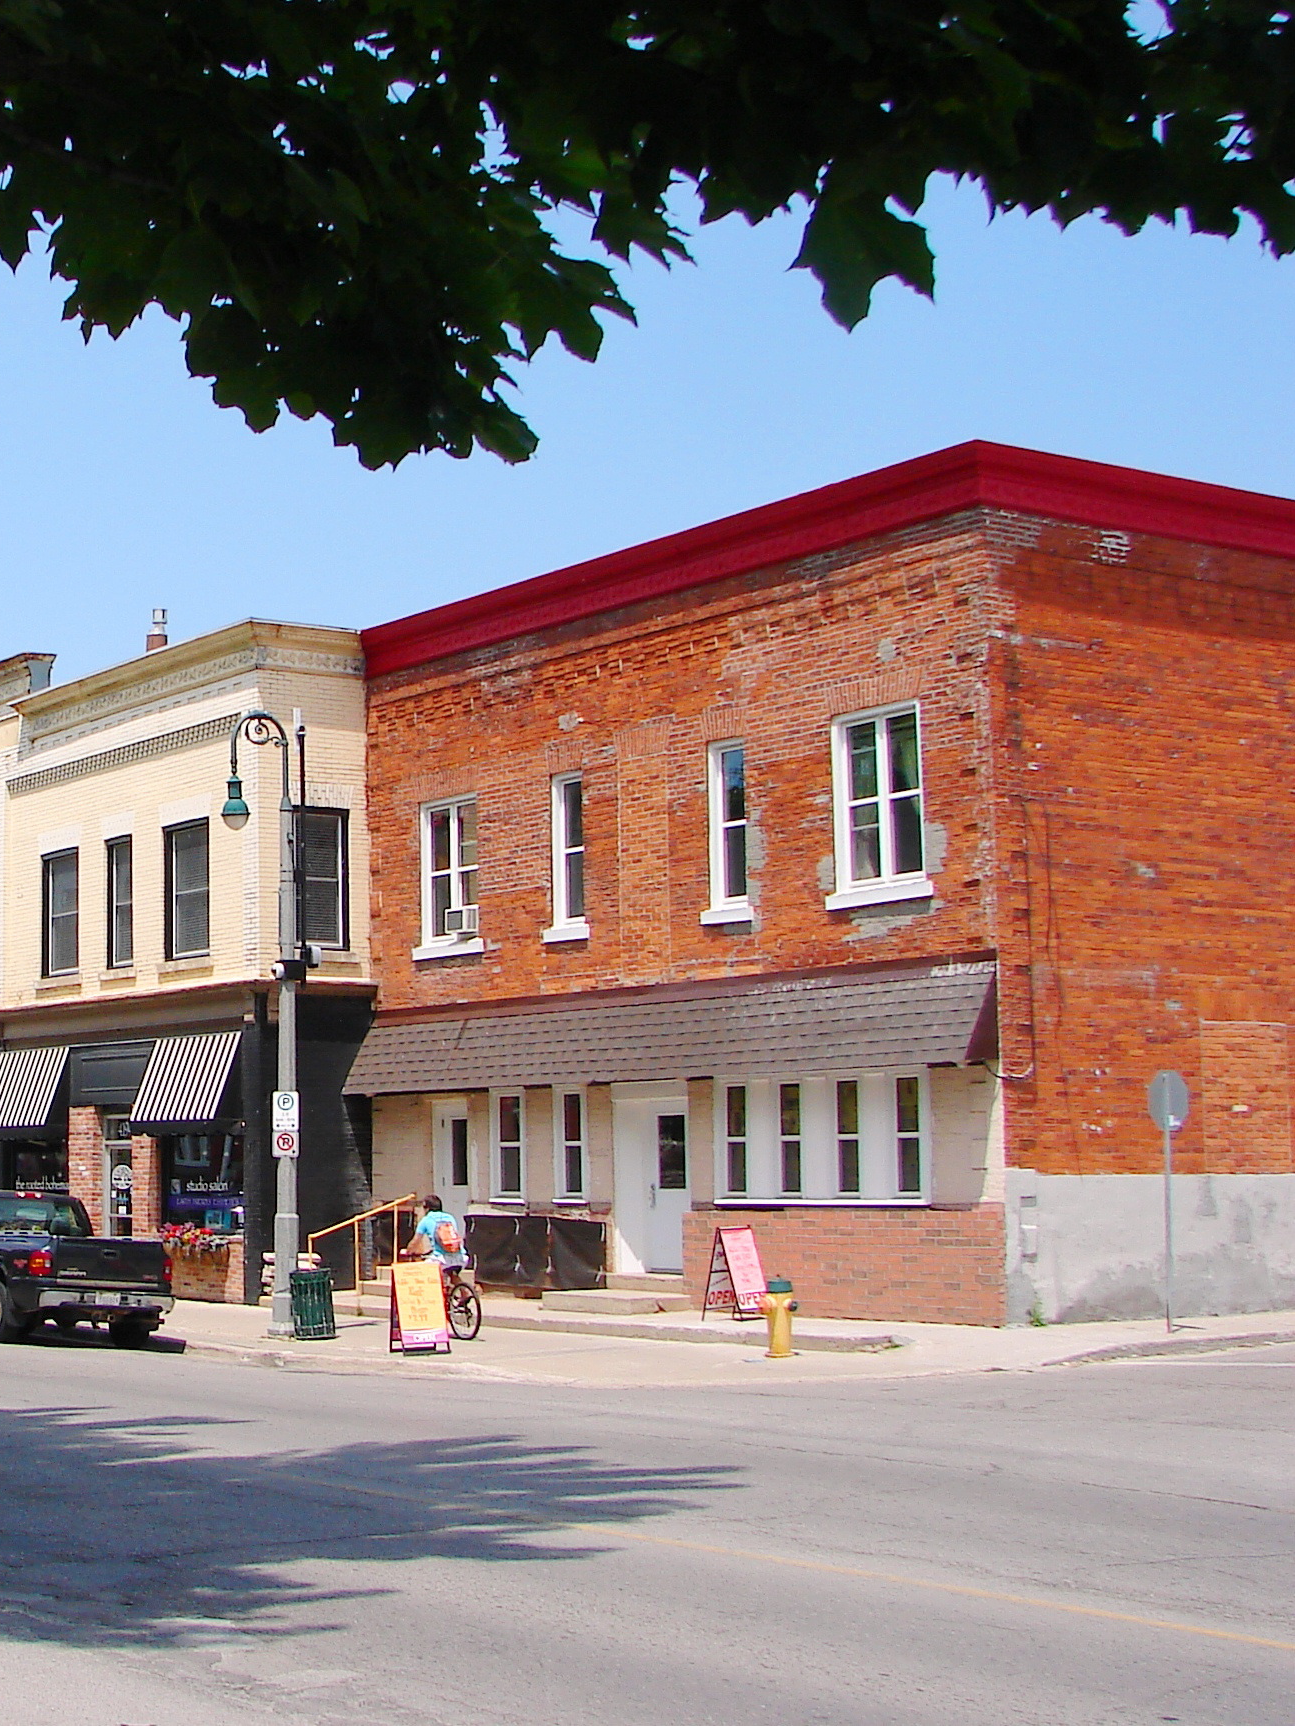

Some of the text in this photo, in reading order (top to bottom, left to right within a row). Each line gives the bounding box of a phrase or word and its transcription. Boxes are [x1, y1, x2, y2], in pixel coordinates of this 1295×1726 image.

[282, 1097, 290, 1107] P
[186, 1175, 228, 1191] studio salon
[738, 1293, 761, 1305] OPE
